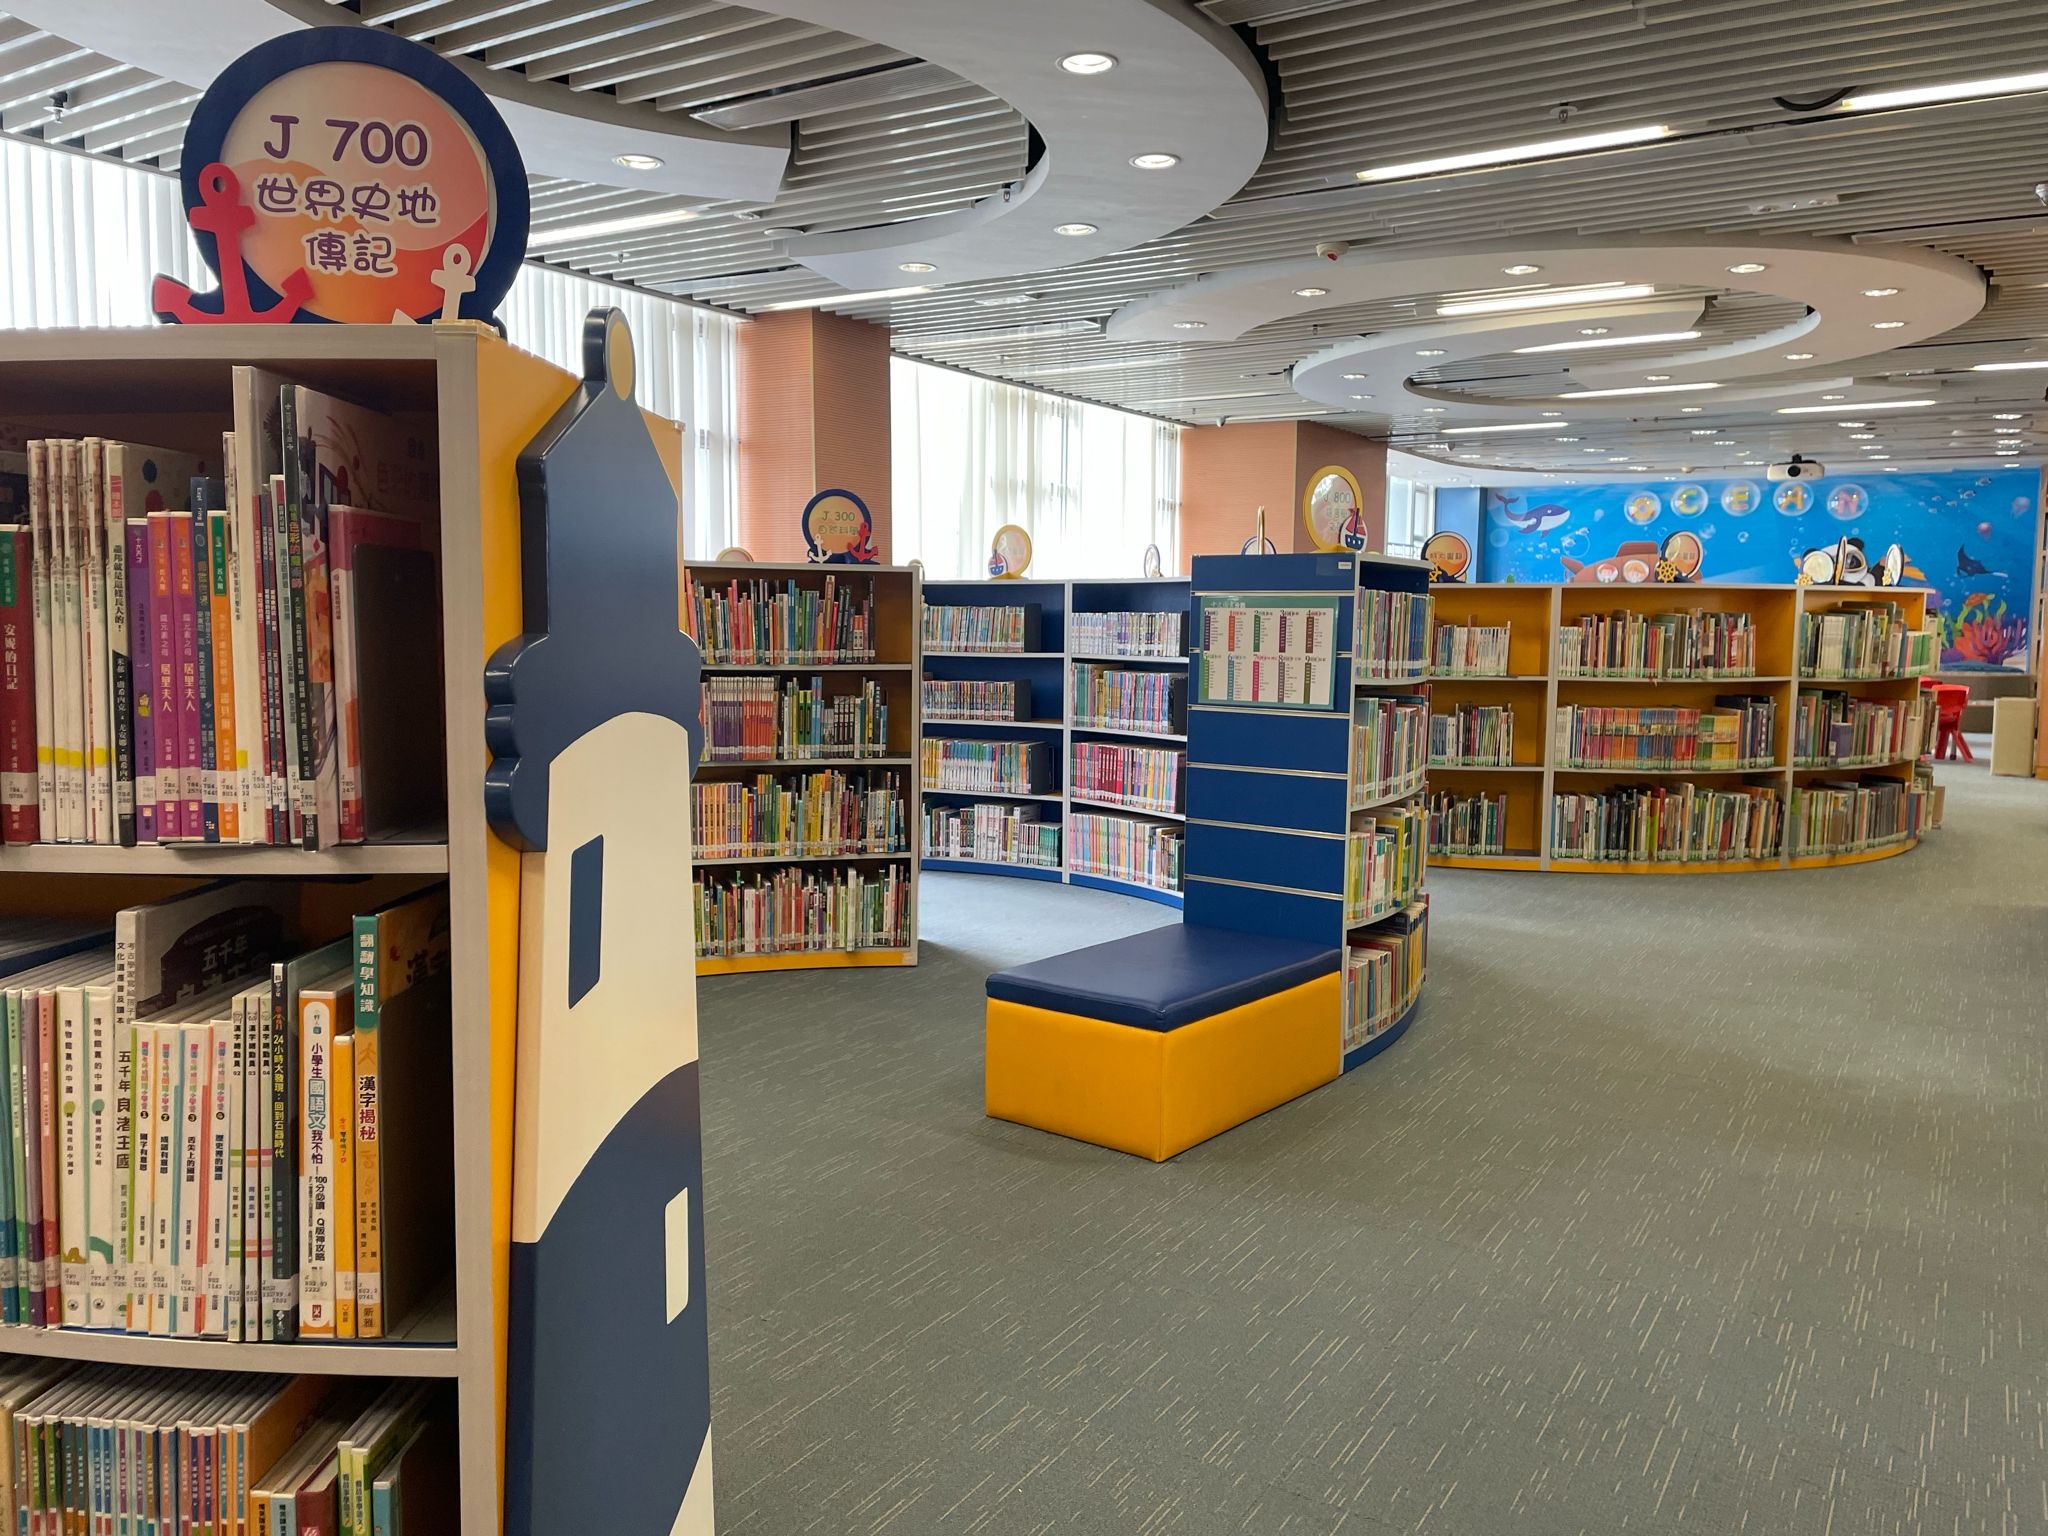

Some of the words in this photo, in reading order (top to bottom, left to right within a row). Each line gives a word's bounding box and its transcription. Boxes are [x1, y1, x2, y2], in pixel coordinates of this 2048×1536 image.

[264, 114, 299, 159] J
[325, 119, 428, 167] 700
[257, 177, 438, 224] 世界史地
[306, 231, 394, 274] 傳記
[822, 511, 829, 521] J
[835, 512, 855, 521] 300
[4, 623, 18, 691] 安妮的日記
[160, 663, 172, 713] 居里夫人
[184, 663, 195, 712] 居里夫人
[360, 933, 375, 1013] 翻翻學知識
[116, 1051, 131, 1169] 五千年良渚王國
[309, 1043, 325, 1164] 小學生國語文我不怕
[359, 1076, 376, 1141] 漢字揭秘
[363, 1307, 375, 1329] 新雅
